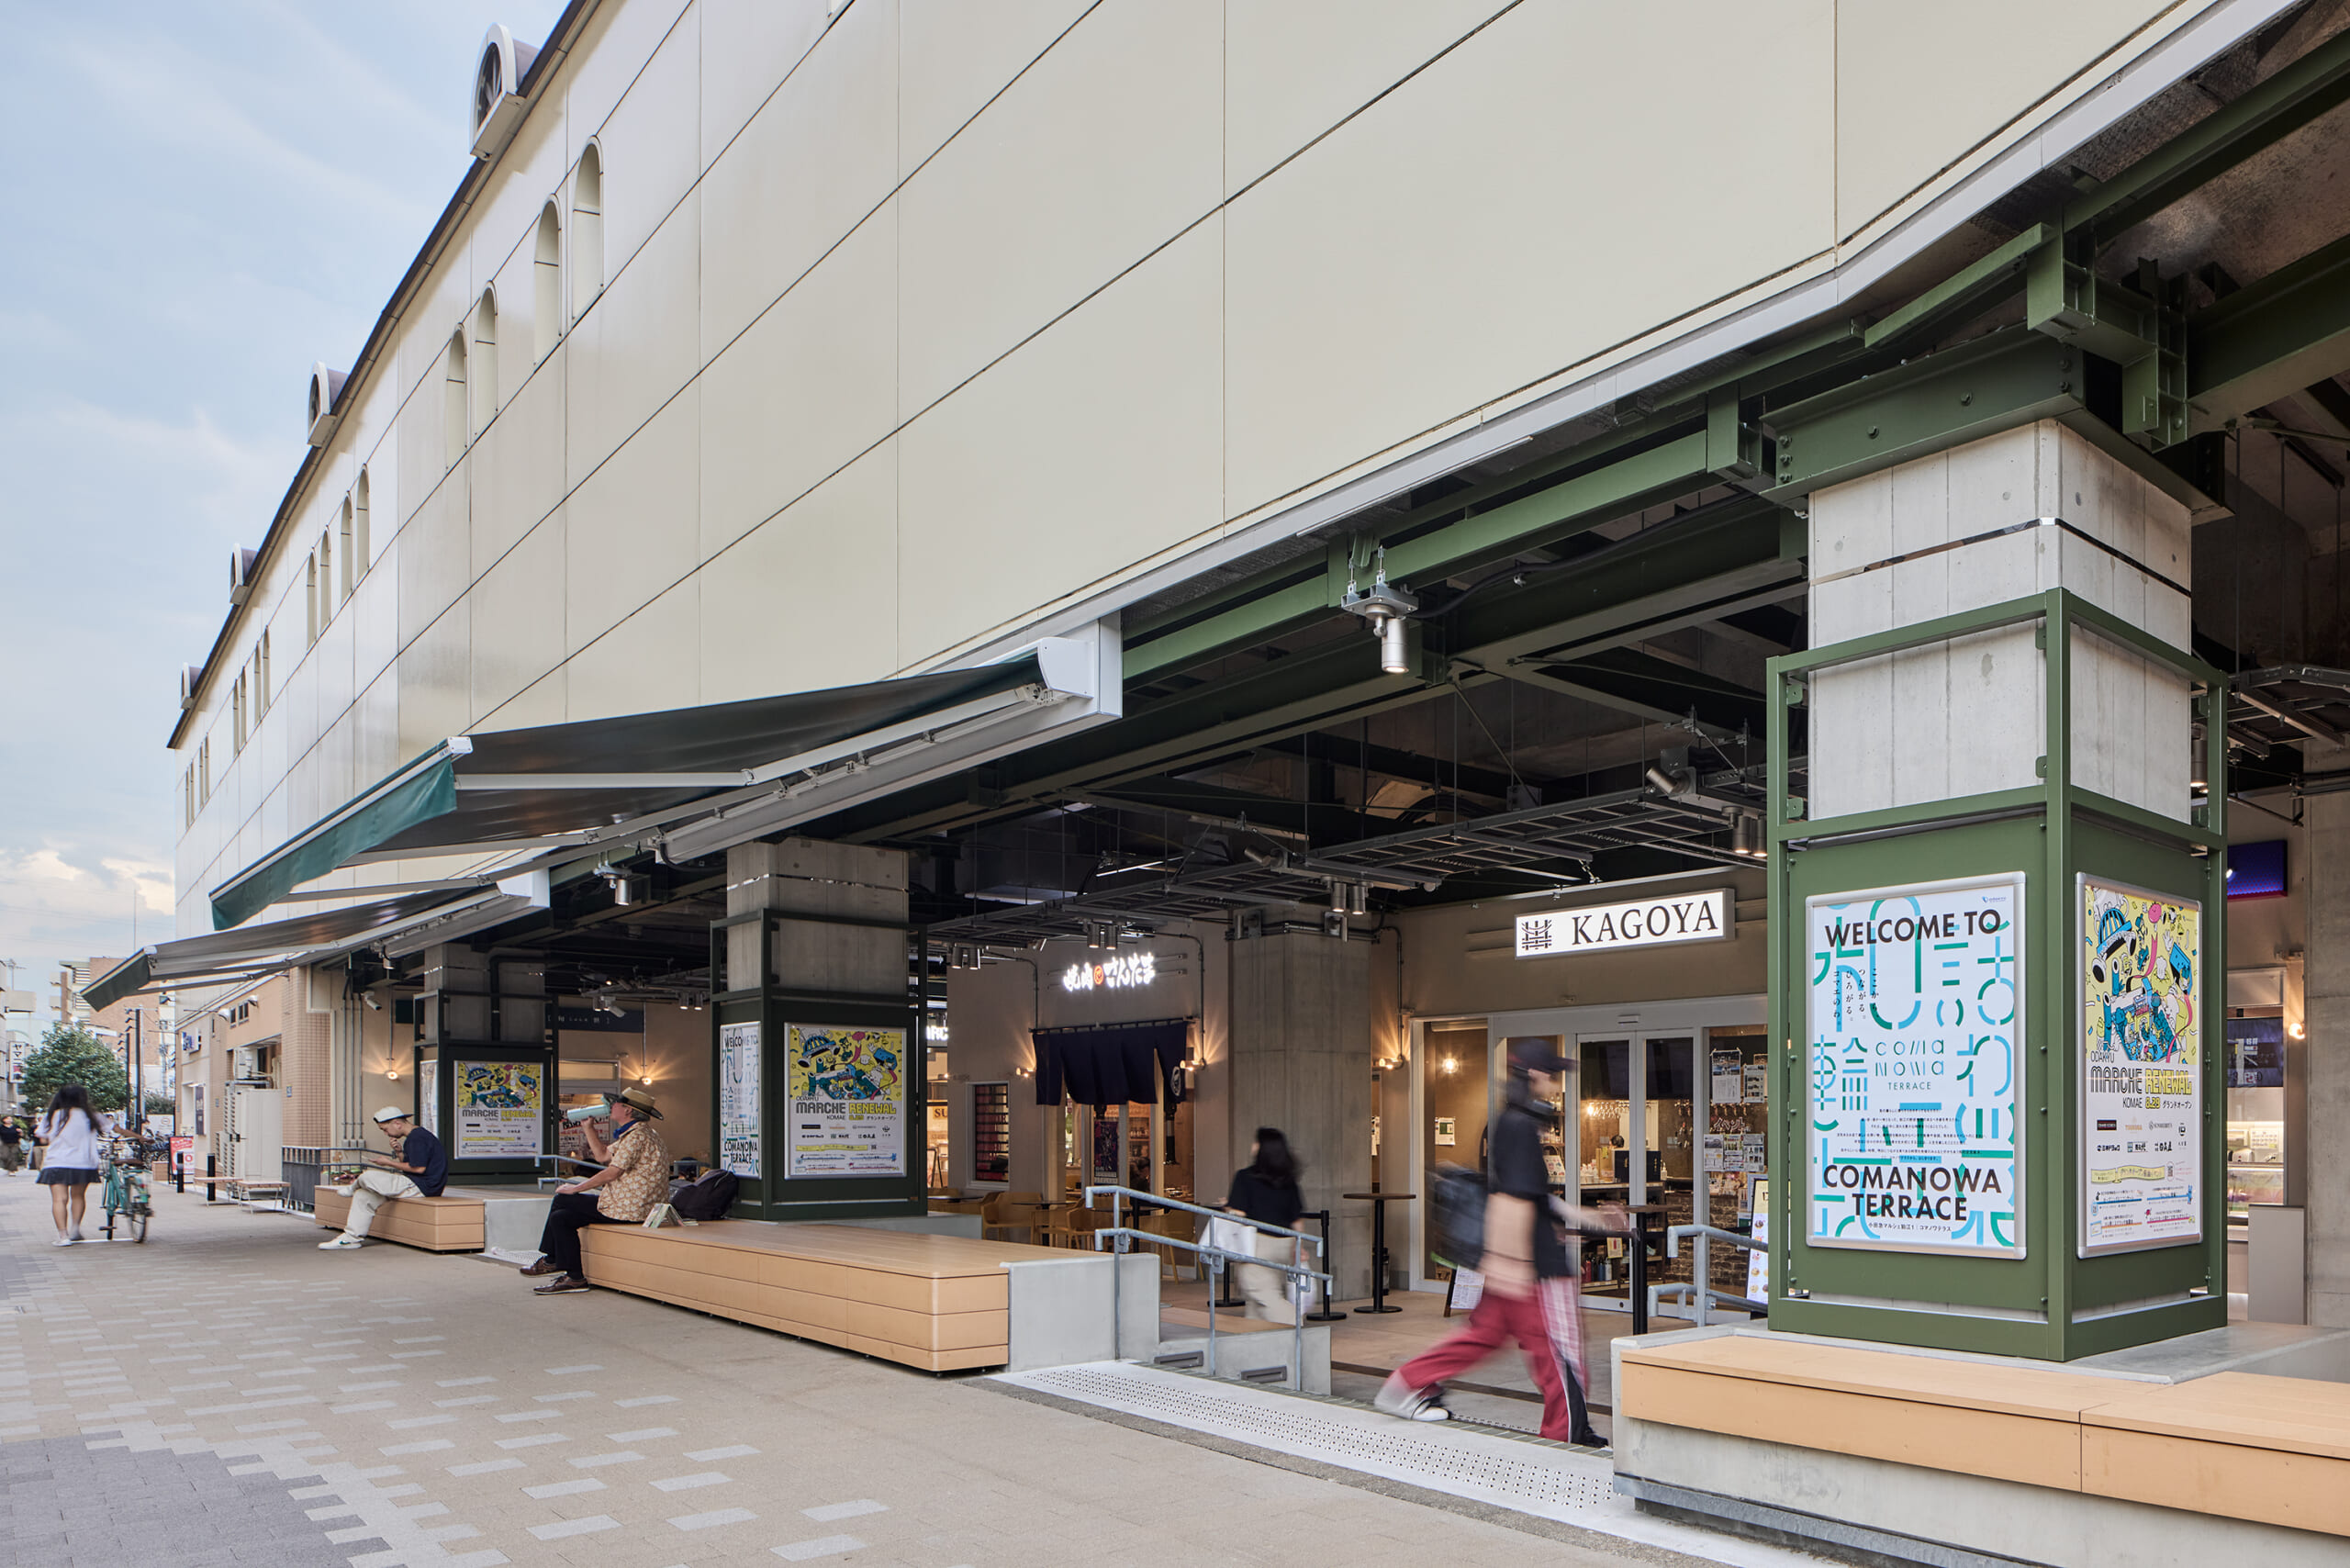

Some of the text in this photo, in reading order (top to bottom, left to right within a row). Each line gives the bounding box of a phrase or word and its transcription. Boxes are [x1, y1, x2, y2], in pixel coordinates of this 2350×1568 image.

[1572, 900, 1718, 946] KAGOYA
[1825, 909, 2001, 948] WELCOME TO
[2090, 1050, 2115, 1063] ODAKYU
[1888, 1081, 1931, 1091] TERRACE
[2091, 1066, 2192, 1095] MARCHE RENEWAL
[796, 1102, 897, 1114] MARCHE RENEWAL
[2122, 1097, 2143, 1108] KOMAE
[2145, 1096, 2160, 1109] 8.29
[462, 1109, 498, 1117] MARCHE
[1823, 1164, 2002, 1194] COMANOWA
[1852, 1193, 1967, 1221] TERRACE
